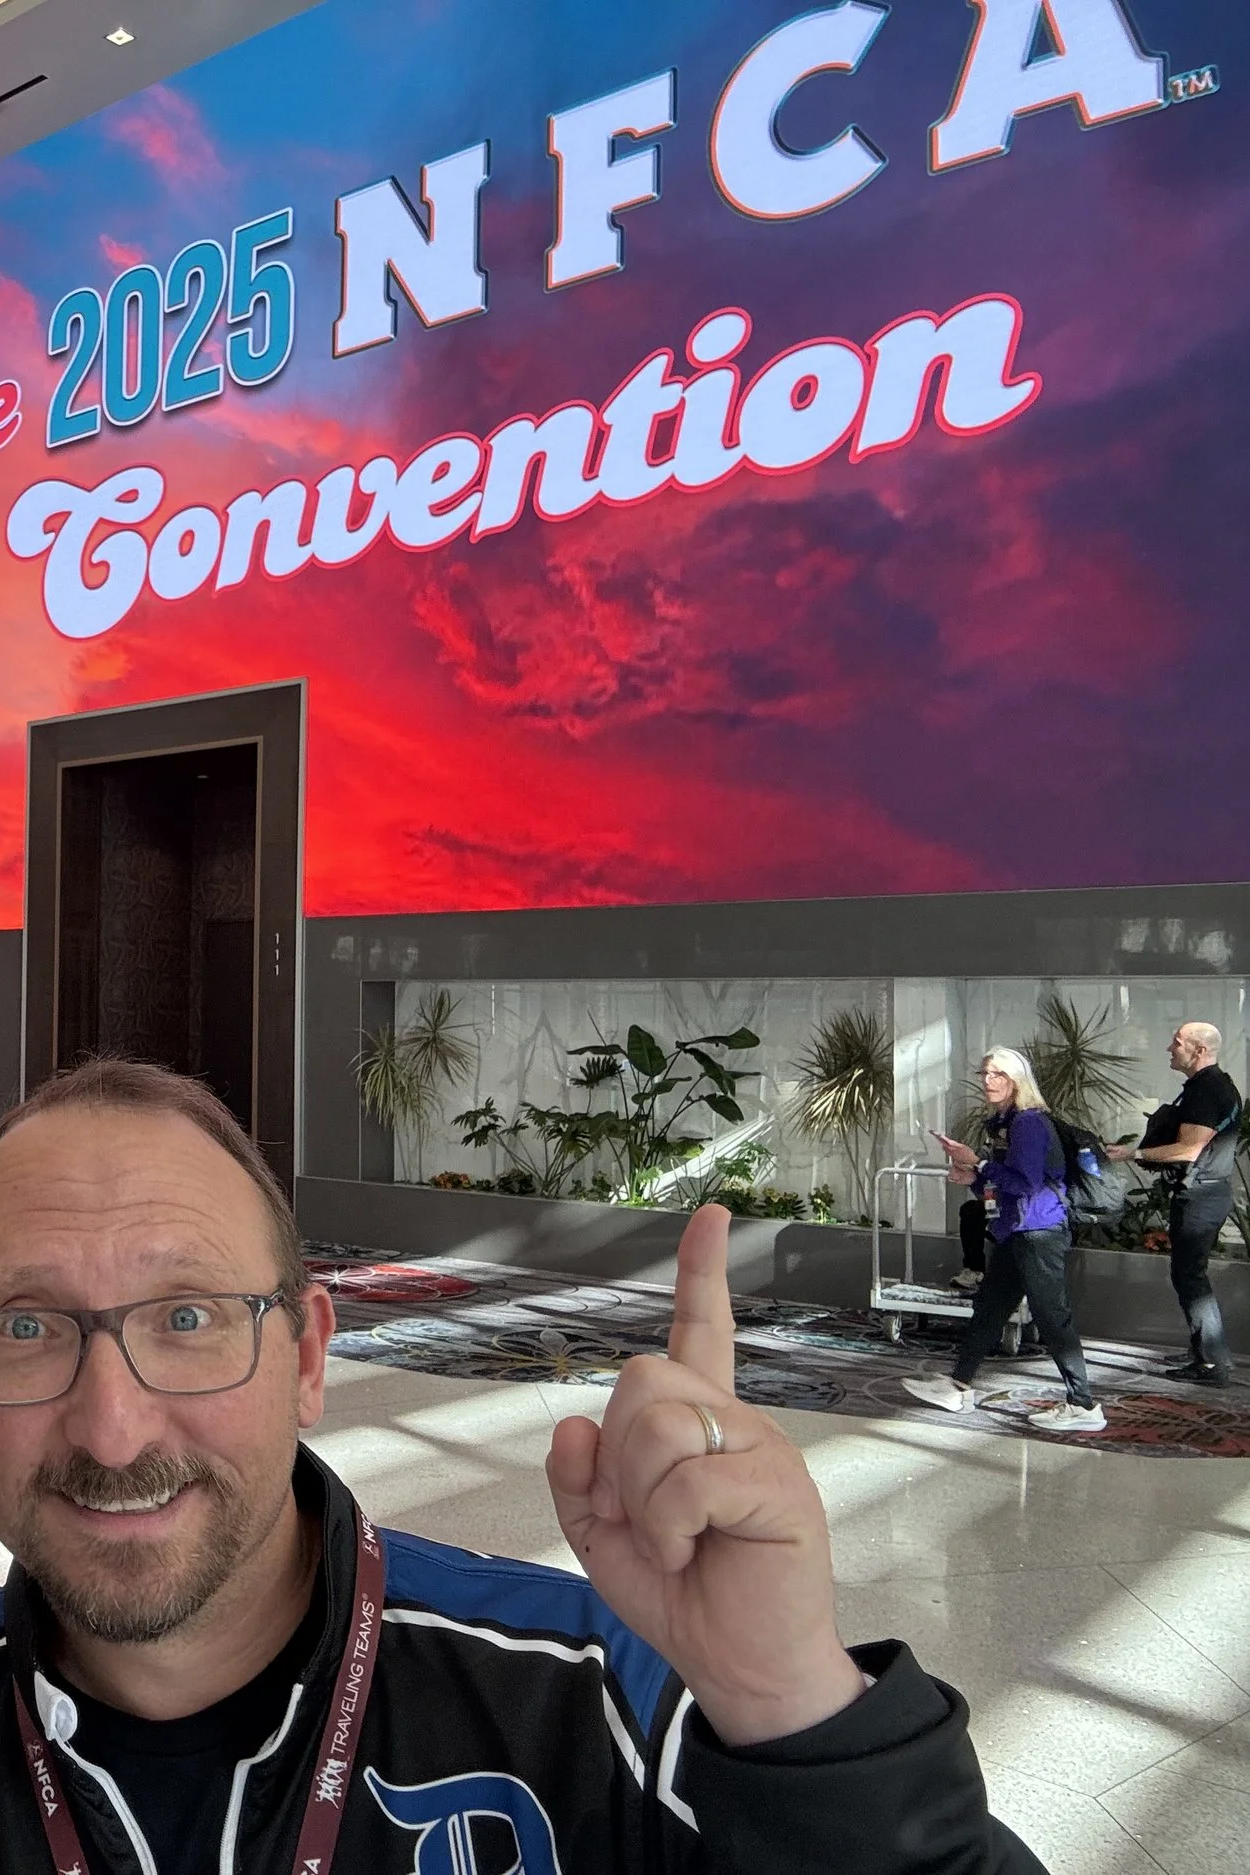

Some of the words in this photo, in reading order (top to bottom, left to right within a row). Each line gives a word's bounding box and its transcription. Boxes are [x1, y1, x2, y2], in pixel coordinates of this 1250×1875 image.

[47, 207, 294, 449] 2025
[333, 0, 1168, 358] NFCA
[6, 292, 1043, 641] Convention
[33, 1758, 59, 1818] NFCA
[330, 1663, 364, 1755] TRAVELING
